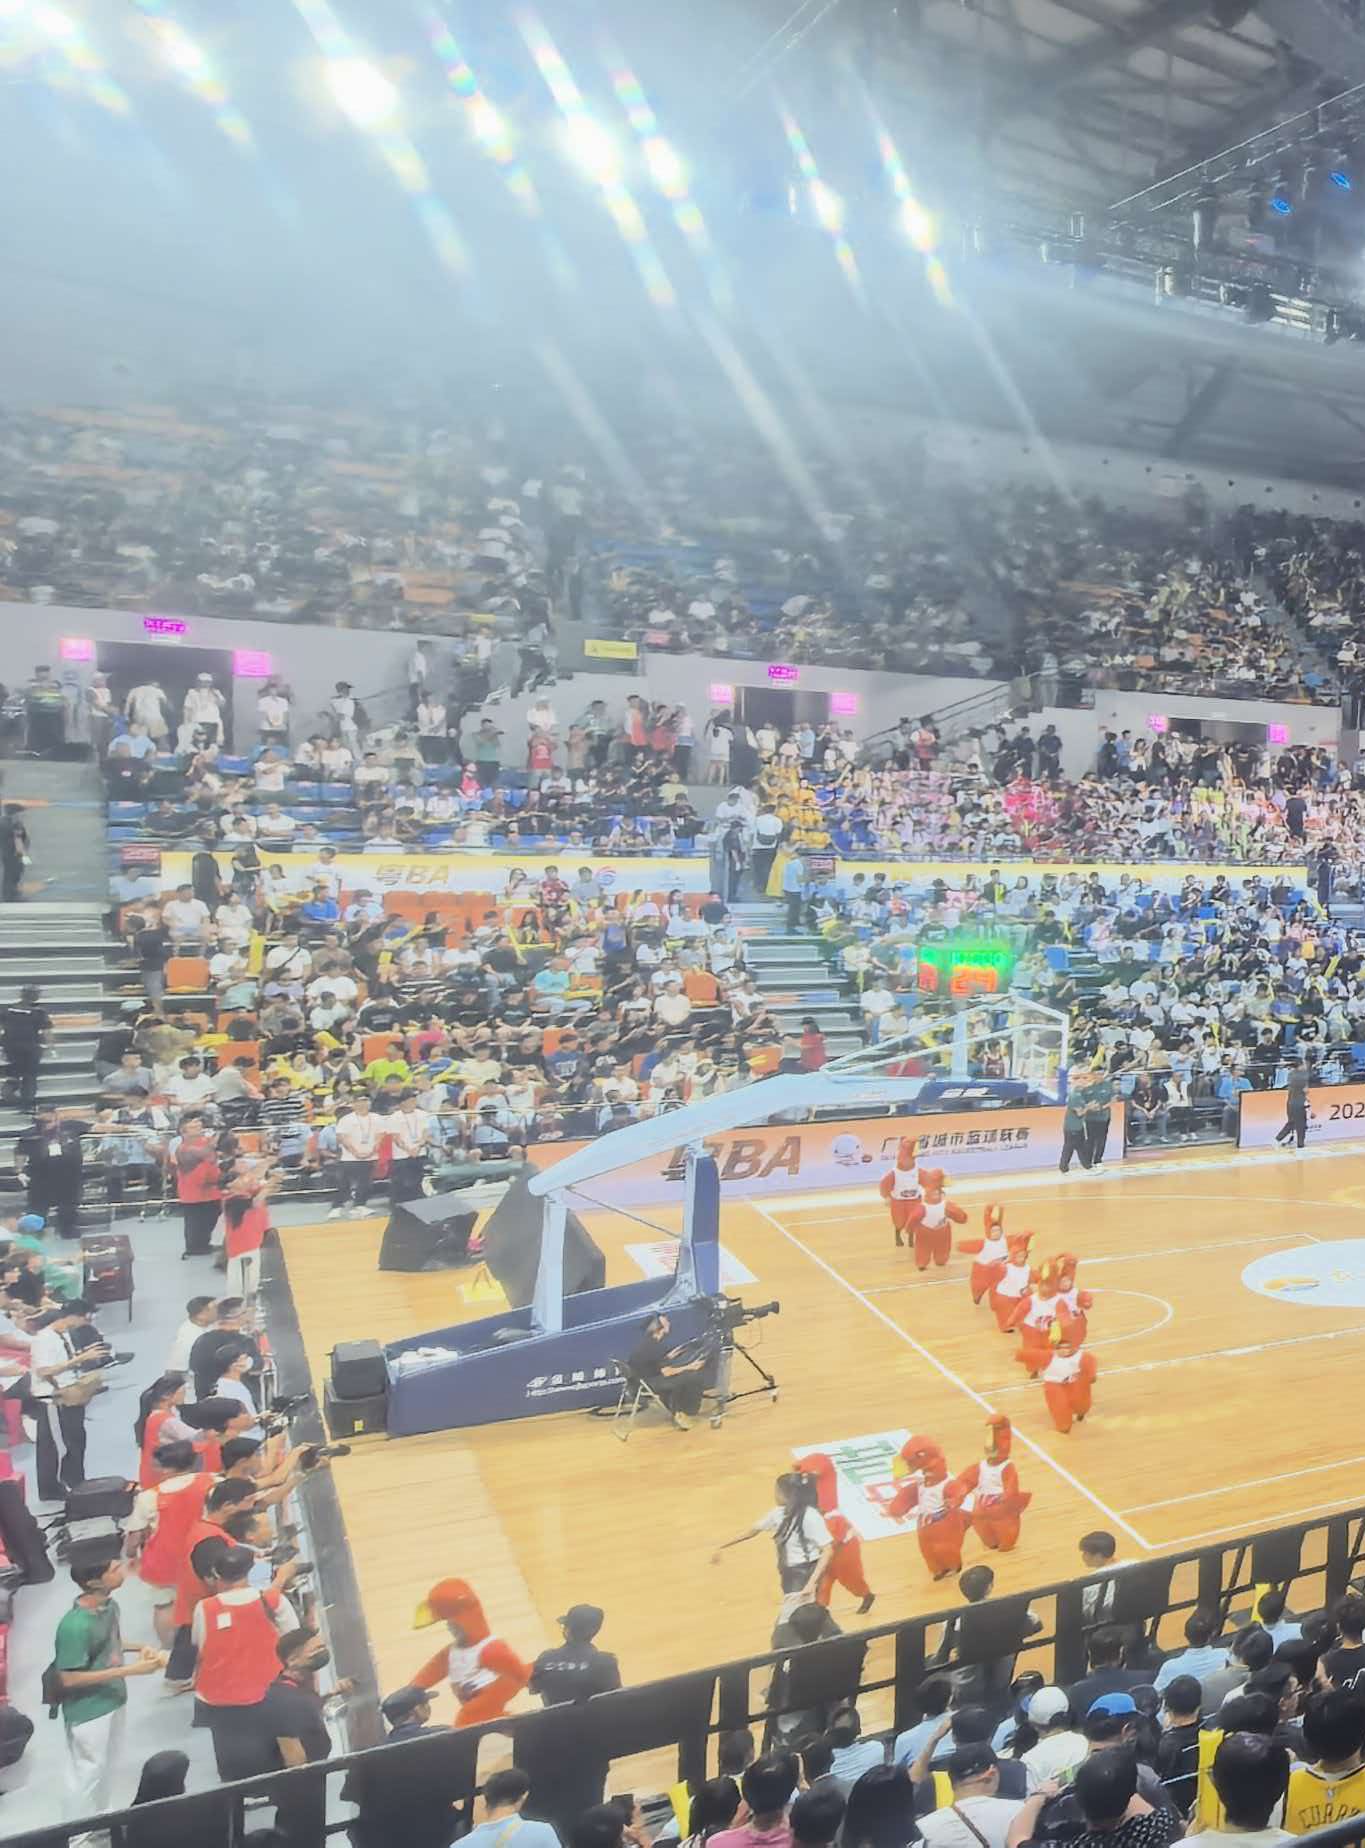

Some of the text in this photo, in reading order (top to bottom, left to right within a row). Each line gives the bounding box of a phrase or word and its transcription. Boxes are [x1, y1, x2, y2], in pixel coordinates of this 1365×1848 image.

[880, 1126, 1031, 1152] 广省城市篮球联赛
